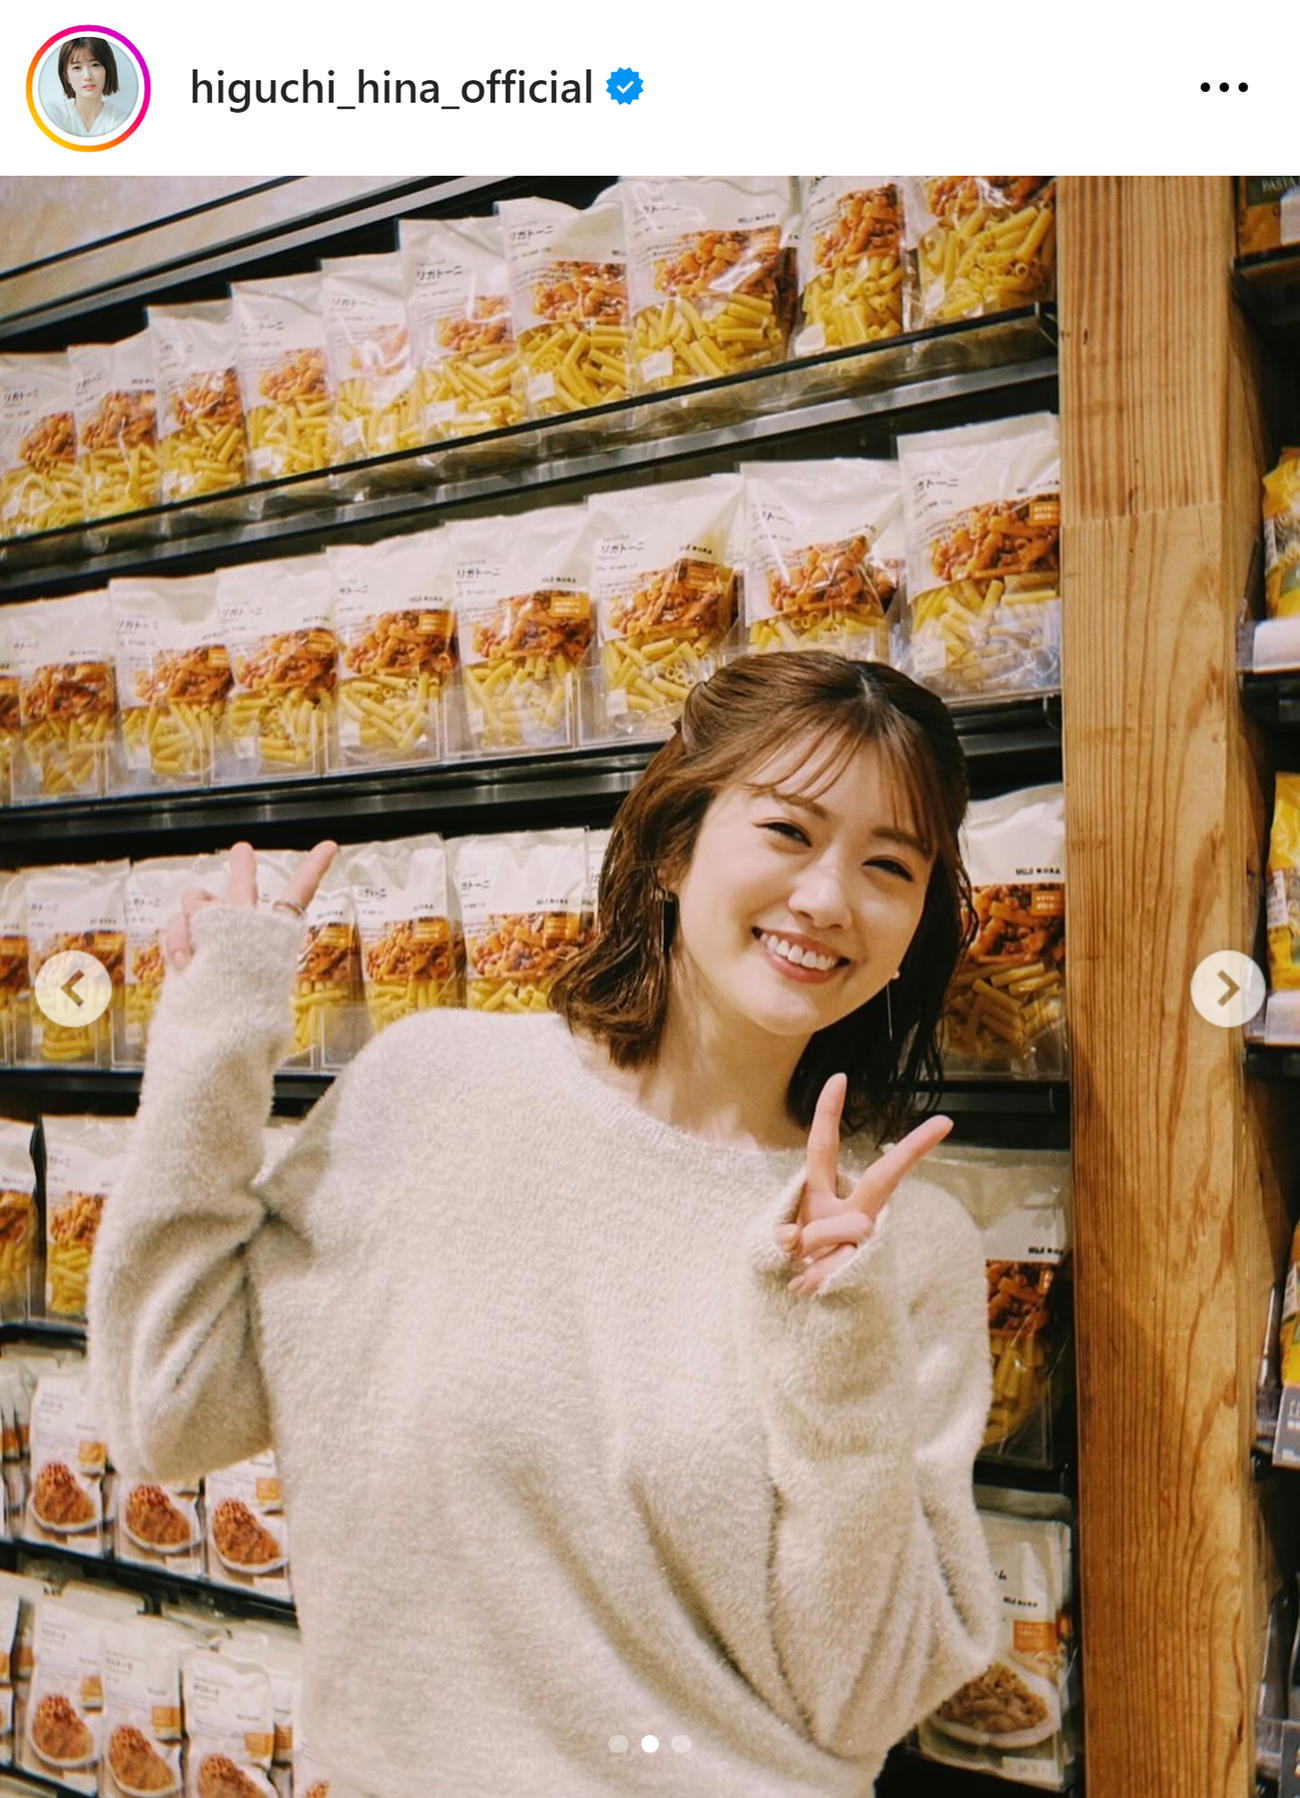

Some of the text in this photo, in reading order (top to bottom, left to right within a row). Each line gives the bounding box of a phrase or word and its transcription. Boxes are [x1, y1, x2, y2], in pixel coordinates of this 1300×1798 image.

[416, 265, 463, 281] リガトーニ
